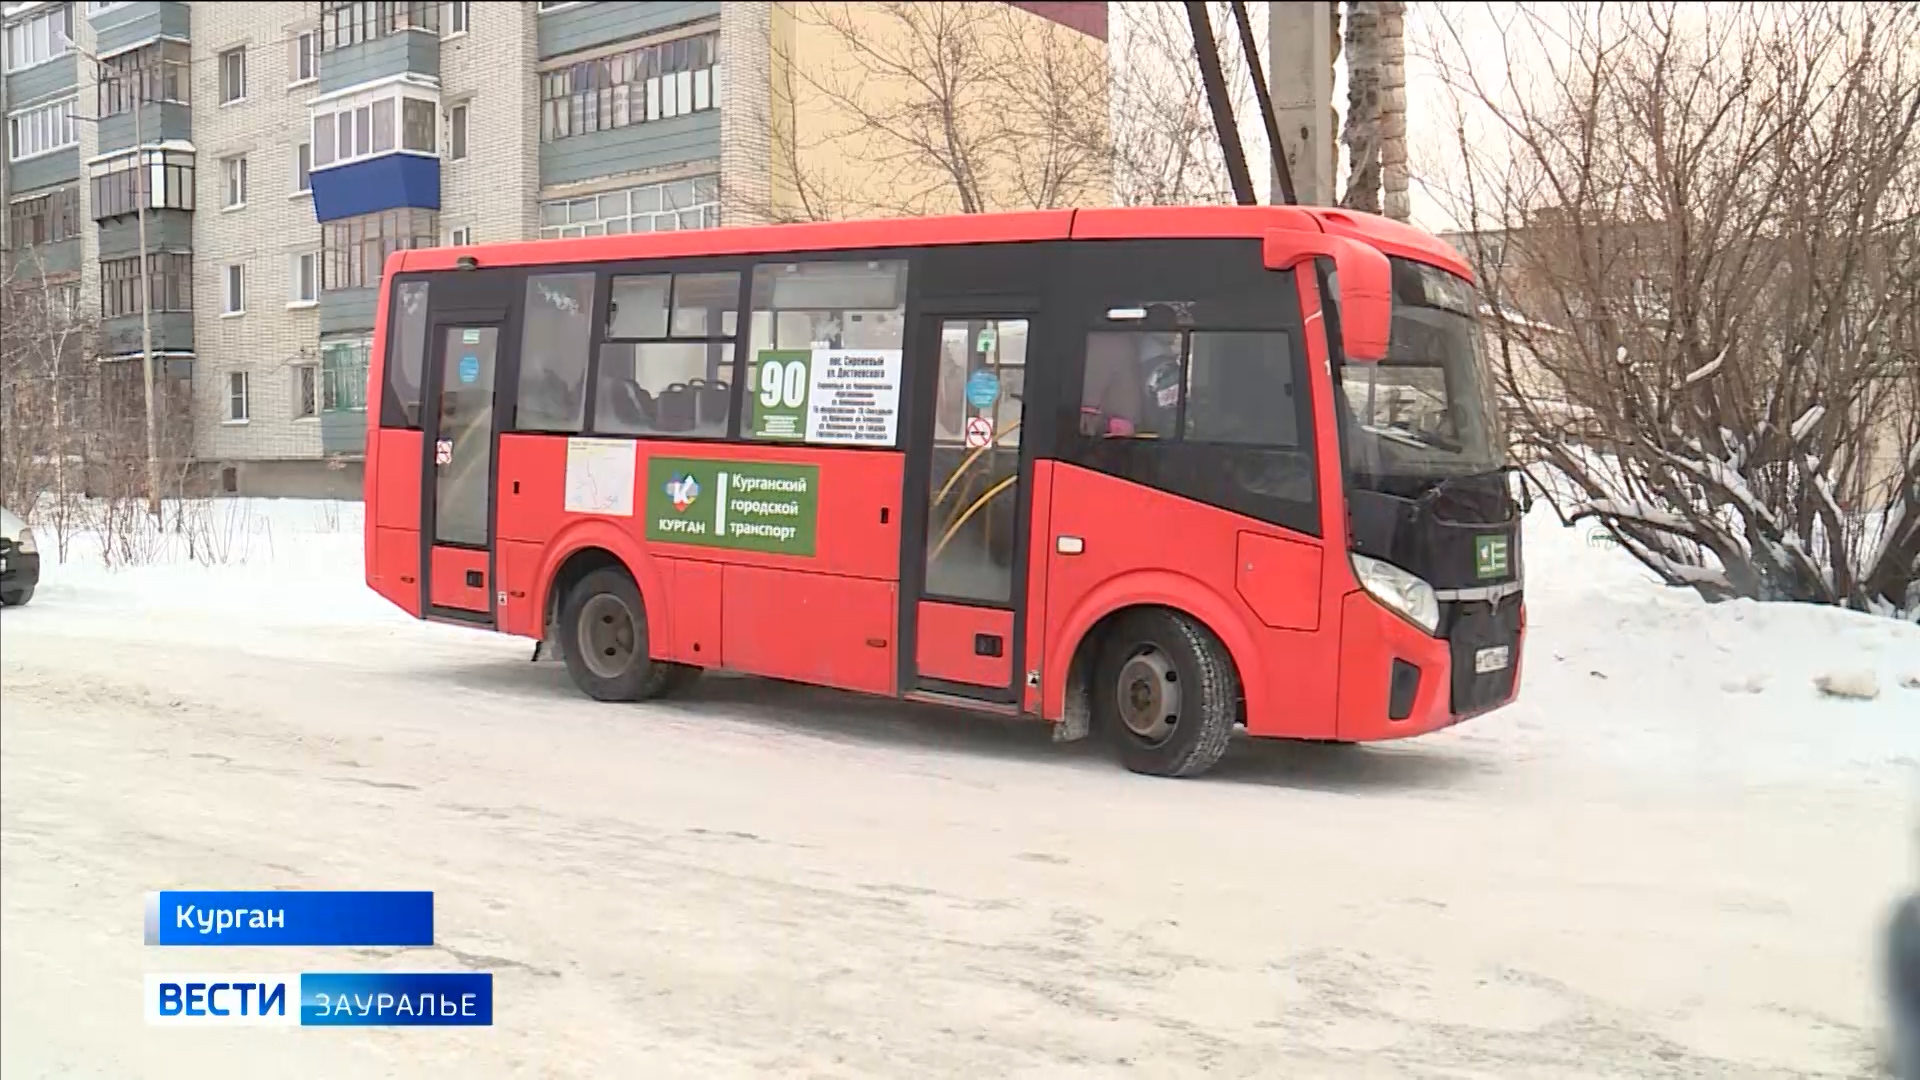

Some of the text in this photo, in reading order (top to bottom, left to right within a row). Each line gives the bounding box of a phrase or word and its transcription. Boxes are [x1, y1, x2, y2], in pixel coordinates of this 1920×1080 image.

[837, 367, 885, 378] Достоевского
[760, 360, 806, 408] 90
[732, 473, 806, 493] Курганский
[730, 499, 799, 517] городской
[658, 517, 706, 535] КУРГАН
[729, 520, 797, 542] транспорт
